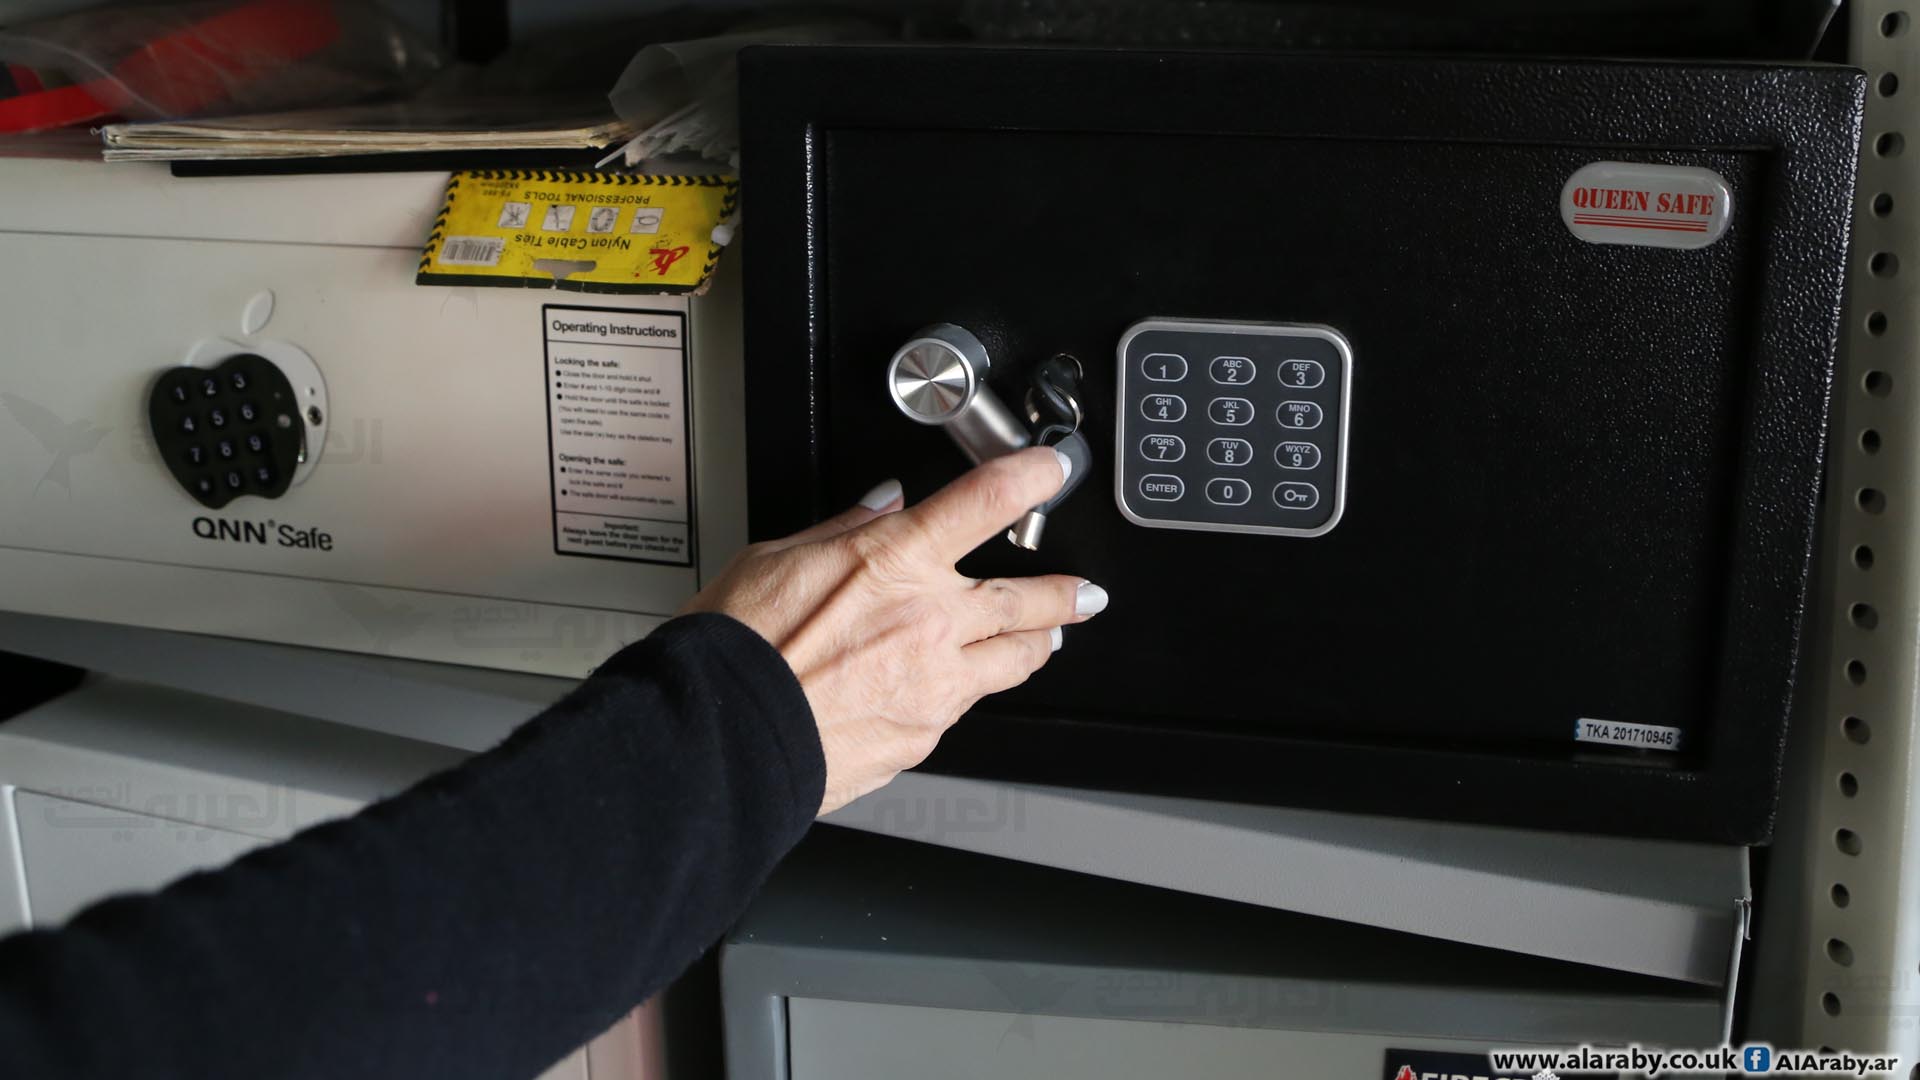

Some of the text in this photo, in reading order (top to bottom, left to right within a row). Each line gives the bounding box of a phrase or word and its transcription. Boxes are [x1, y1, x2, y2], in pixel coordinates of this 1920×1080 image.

[524, 191, 651, 205] PROFESSIONAL TOOLS
[1573, 187, 1715, 216] QUEEN SAFE
[514, 233, 543, 247] Ties
[547, 234, 588, 250] Cable
[591, 236, 631, 250] Nylon
[552, 320, 677, 338] Operating Instructions
[554, 356, 585, 368] Locking
[587, 359, 600, 367] the
[1222, 360, 1311, 371] ABC DEF
[1159, 365, 1306, 386] 1 2 3
[175, 373, 246, 401] 1 2 3
[1155, 398, 1311, 413] GHI JKL MNO
[184, 404, 254, 431] 4 5 6
[1158, 406, 1305, 427] 4 5 6
[191, 447, 201, 463] 7
[250, 435, 262, 451] 9
[1150, 438, 1311, 454] PQRS TUV WXYZ
[559, 453, 592, 465] Opening
[1157, 446, 1303, 467] 7 8 9
[228, 472, 240, 488] 0
[1146, 483, 1233, 499] ENTER 0
[278, 525, 333, 551] Safe
[1586, 724, 1674, 745] TKA 201710945
